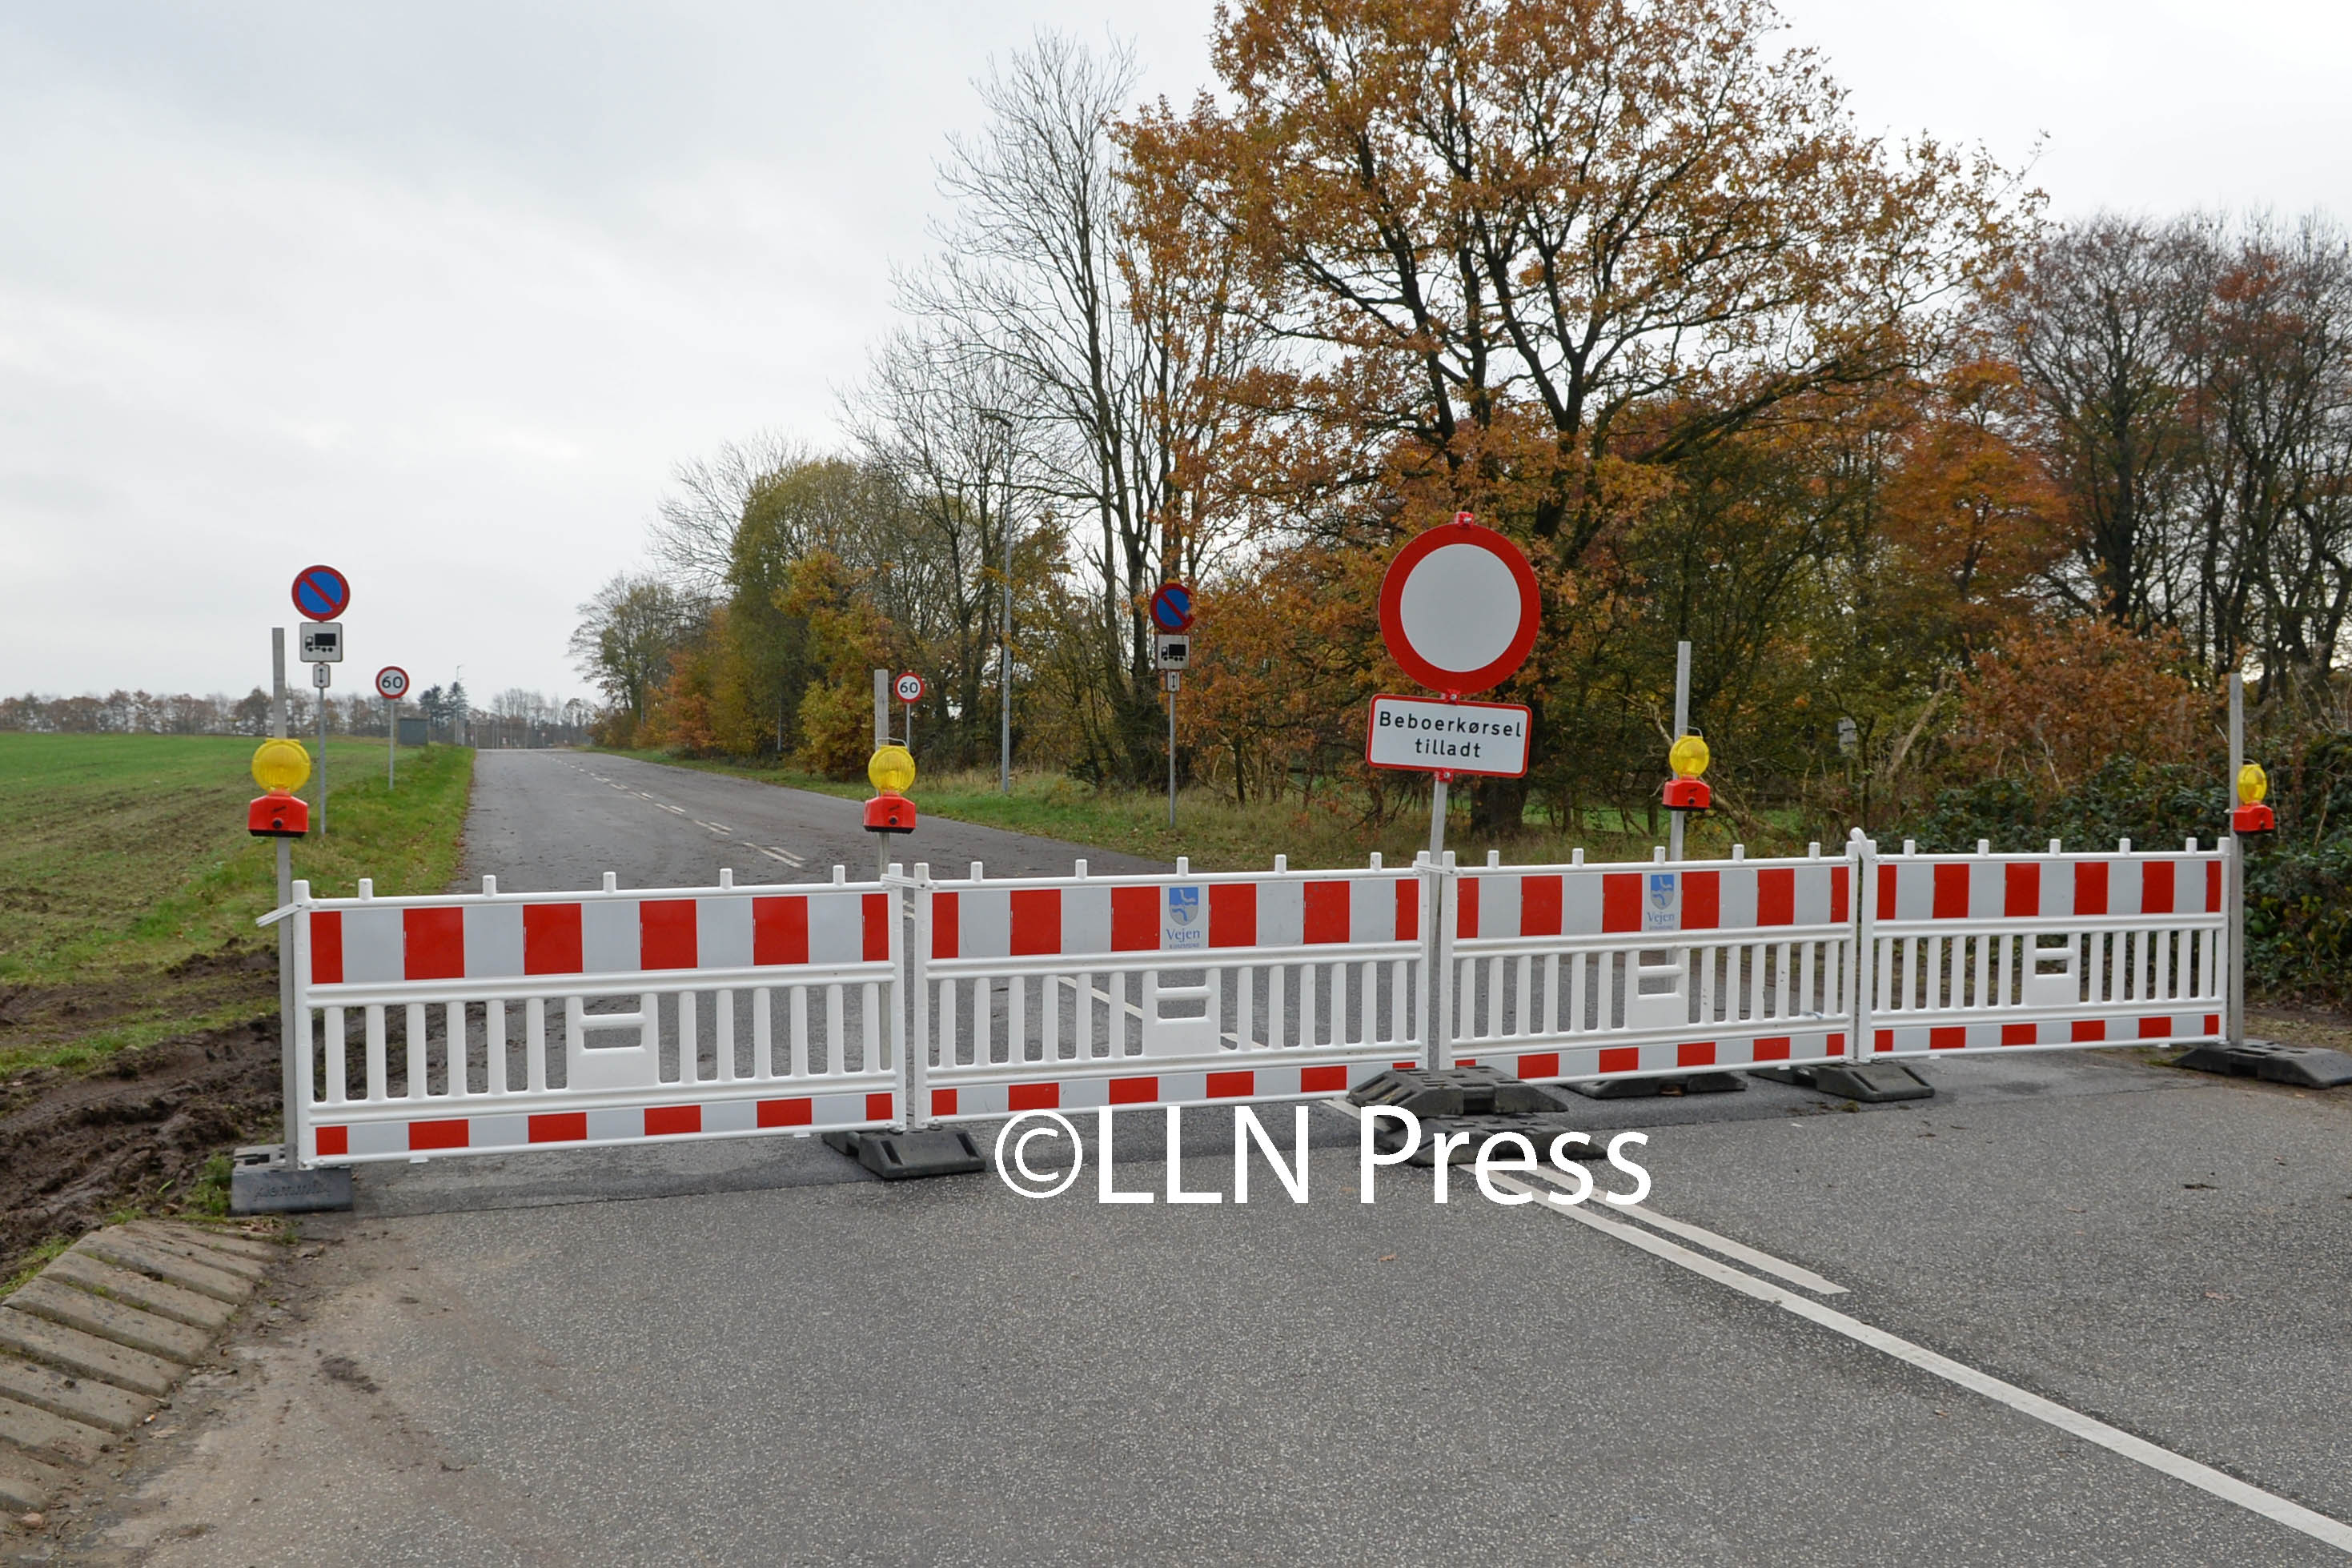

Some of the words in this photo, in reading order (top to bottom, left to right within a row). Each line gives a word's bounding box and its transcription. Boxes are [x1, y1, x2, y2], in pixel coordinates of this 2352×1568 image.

[381, 676, 403, 689] 60
[899, 681, 919, 694] 60
[1379, 710, 1522, 738] Beboerkørsel
[1415, 738, 1482, 759] tilladt
[1166, 927, 1201, 943] Vejen
